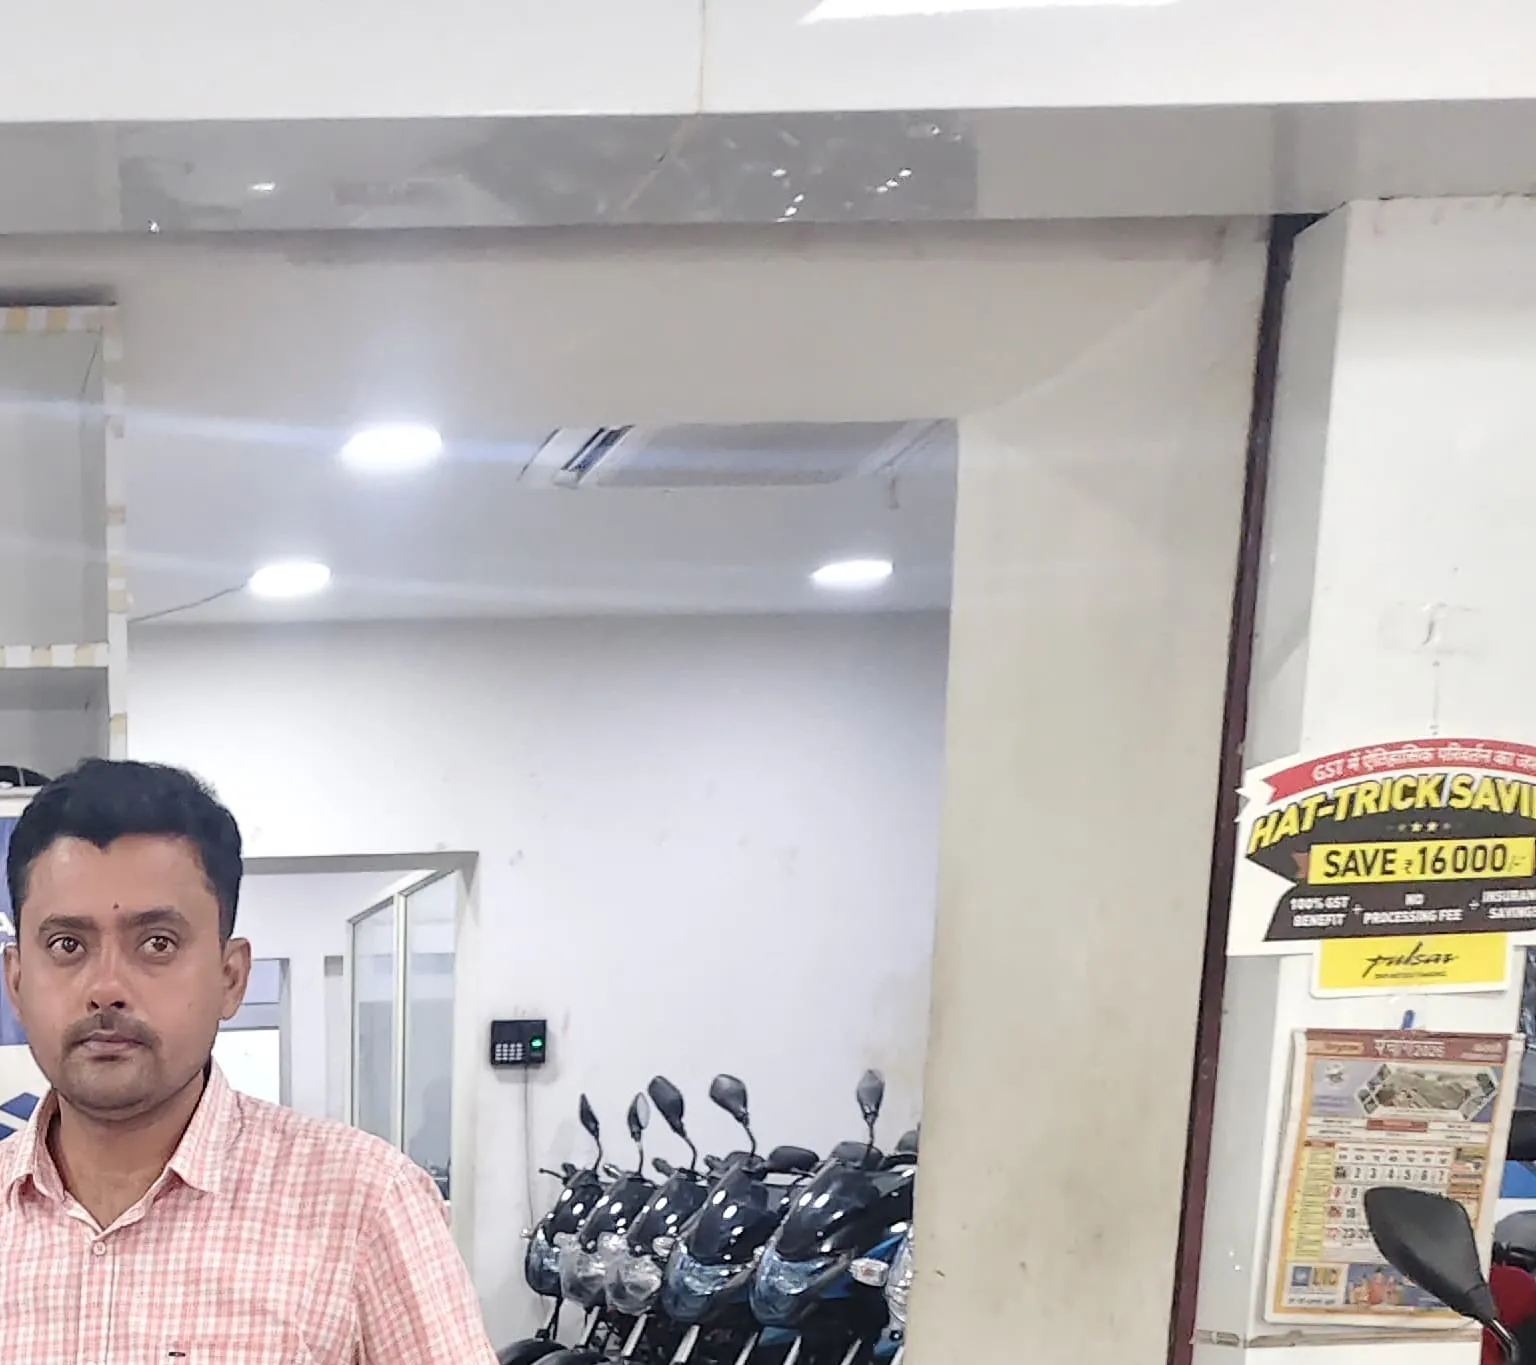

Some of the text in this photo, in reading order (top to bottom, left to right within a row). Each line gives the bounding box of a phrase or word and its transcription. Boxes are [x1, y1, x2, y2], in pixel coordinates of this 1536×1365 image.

[1246, 773, 1448, 857] HAT-TRICK
[1324, 848, 1397, 878] SAVE
[1324, 896, 1351, 909] GST
[1363, 908, 1463, 925] PROCESSING FEE
